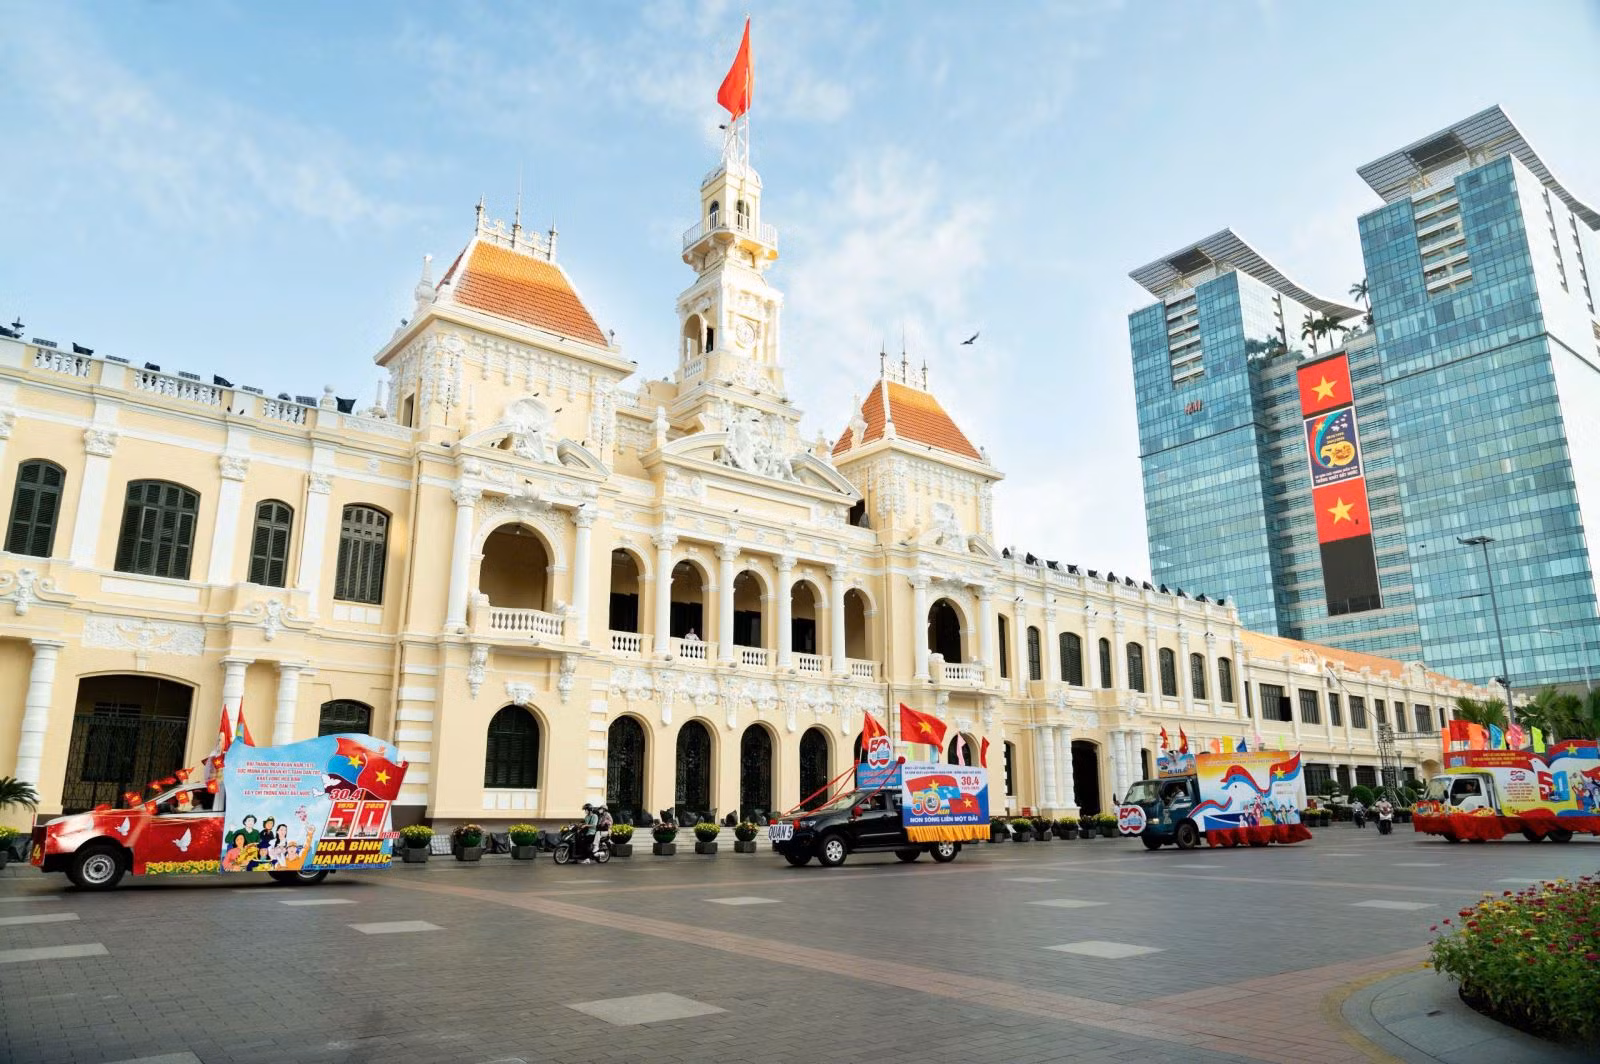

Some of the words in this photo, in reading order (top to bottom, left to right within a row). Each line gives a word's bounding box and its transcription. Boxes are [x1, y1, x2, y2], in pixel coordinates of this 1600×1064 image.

[961, 776, 979, 786] 30.4
[329, 788, 362, 800] 30.4
[911, 791, 941, 816] 50
[768, 823, 787, 843] QUẬN
[786, 824, 794, 840] 5
[317, 840, 345, 851] HOÀ
[349, 840, 383, 851] BÌNH
[33, 844, 41, 860] 4
[312, 854, 352, 865] HẠNH
[354, 854, 392, 864] PHÚC
